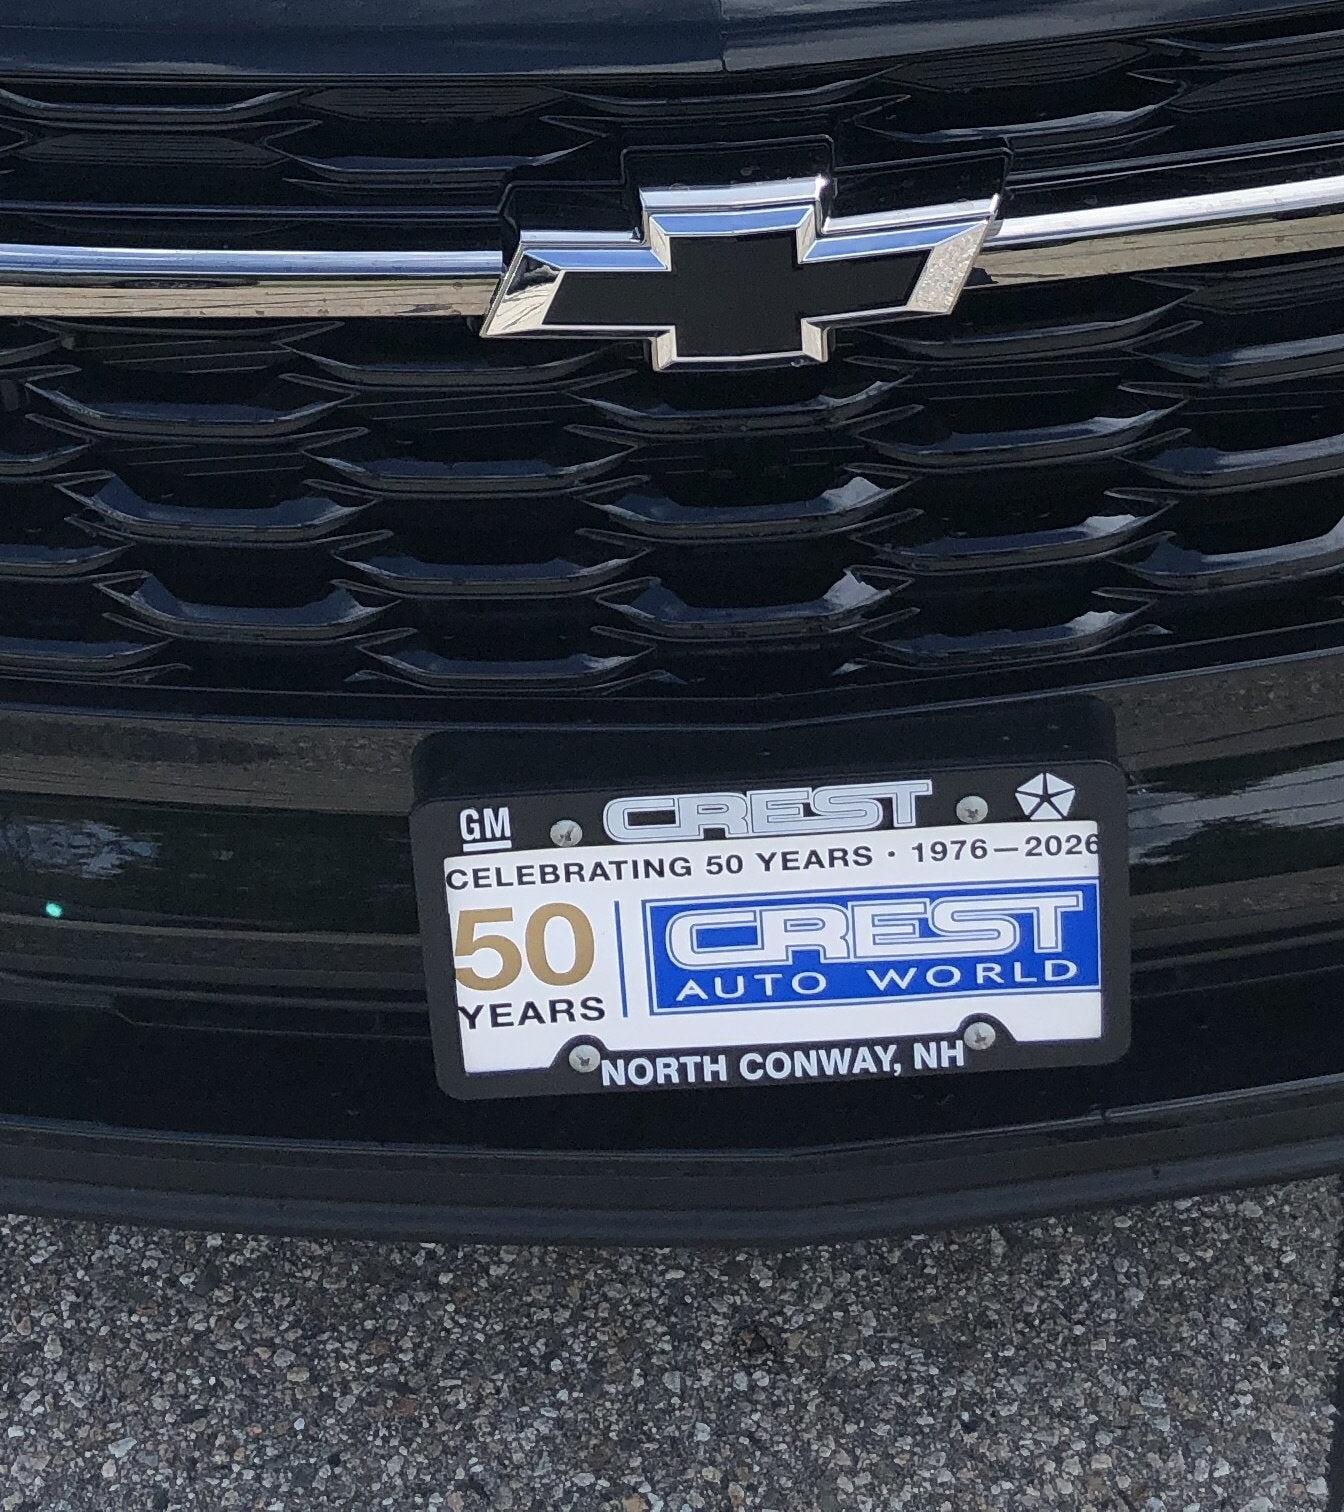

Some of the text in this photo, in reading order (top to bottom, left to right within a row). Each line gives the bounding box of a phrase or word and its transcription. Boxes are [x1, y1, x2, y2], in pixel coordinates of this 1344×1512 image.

[459, 807, 512, 841] GM
[602, 779, 933, 843] CREST
[445, 855, 692, 890] CELEBRATING
[705, 853, 744, 876] 50
[755, 845, 873, 872] YEARS
[455, 902, 595, 992] 50
[665, 891, 1083, 968] CREST
[675, 959, 1078, 1002] AUTO WORLD
[457, 996, 606, 1030] YEARS
[601, 1039, 965, 1087] NORTH CONWAY, NH
